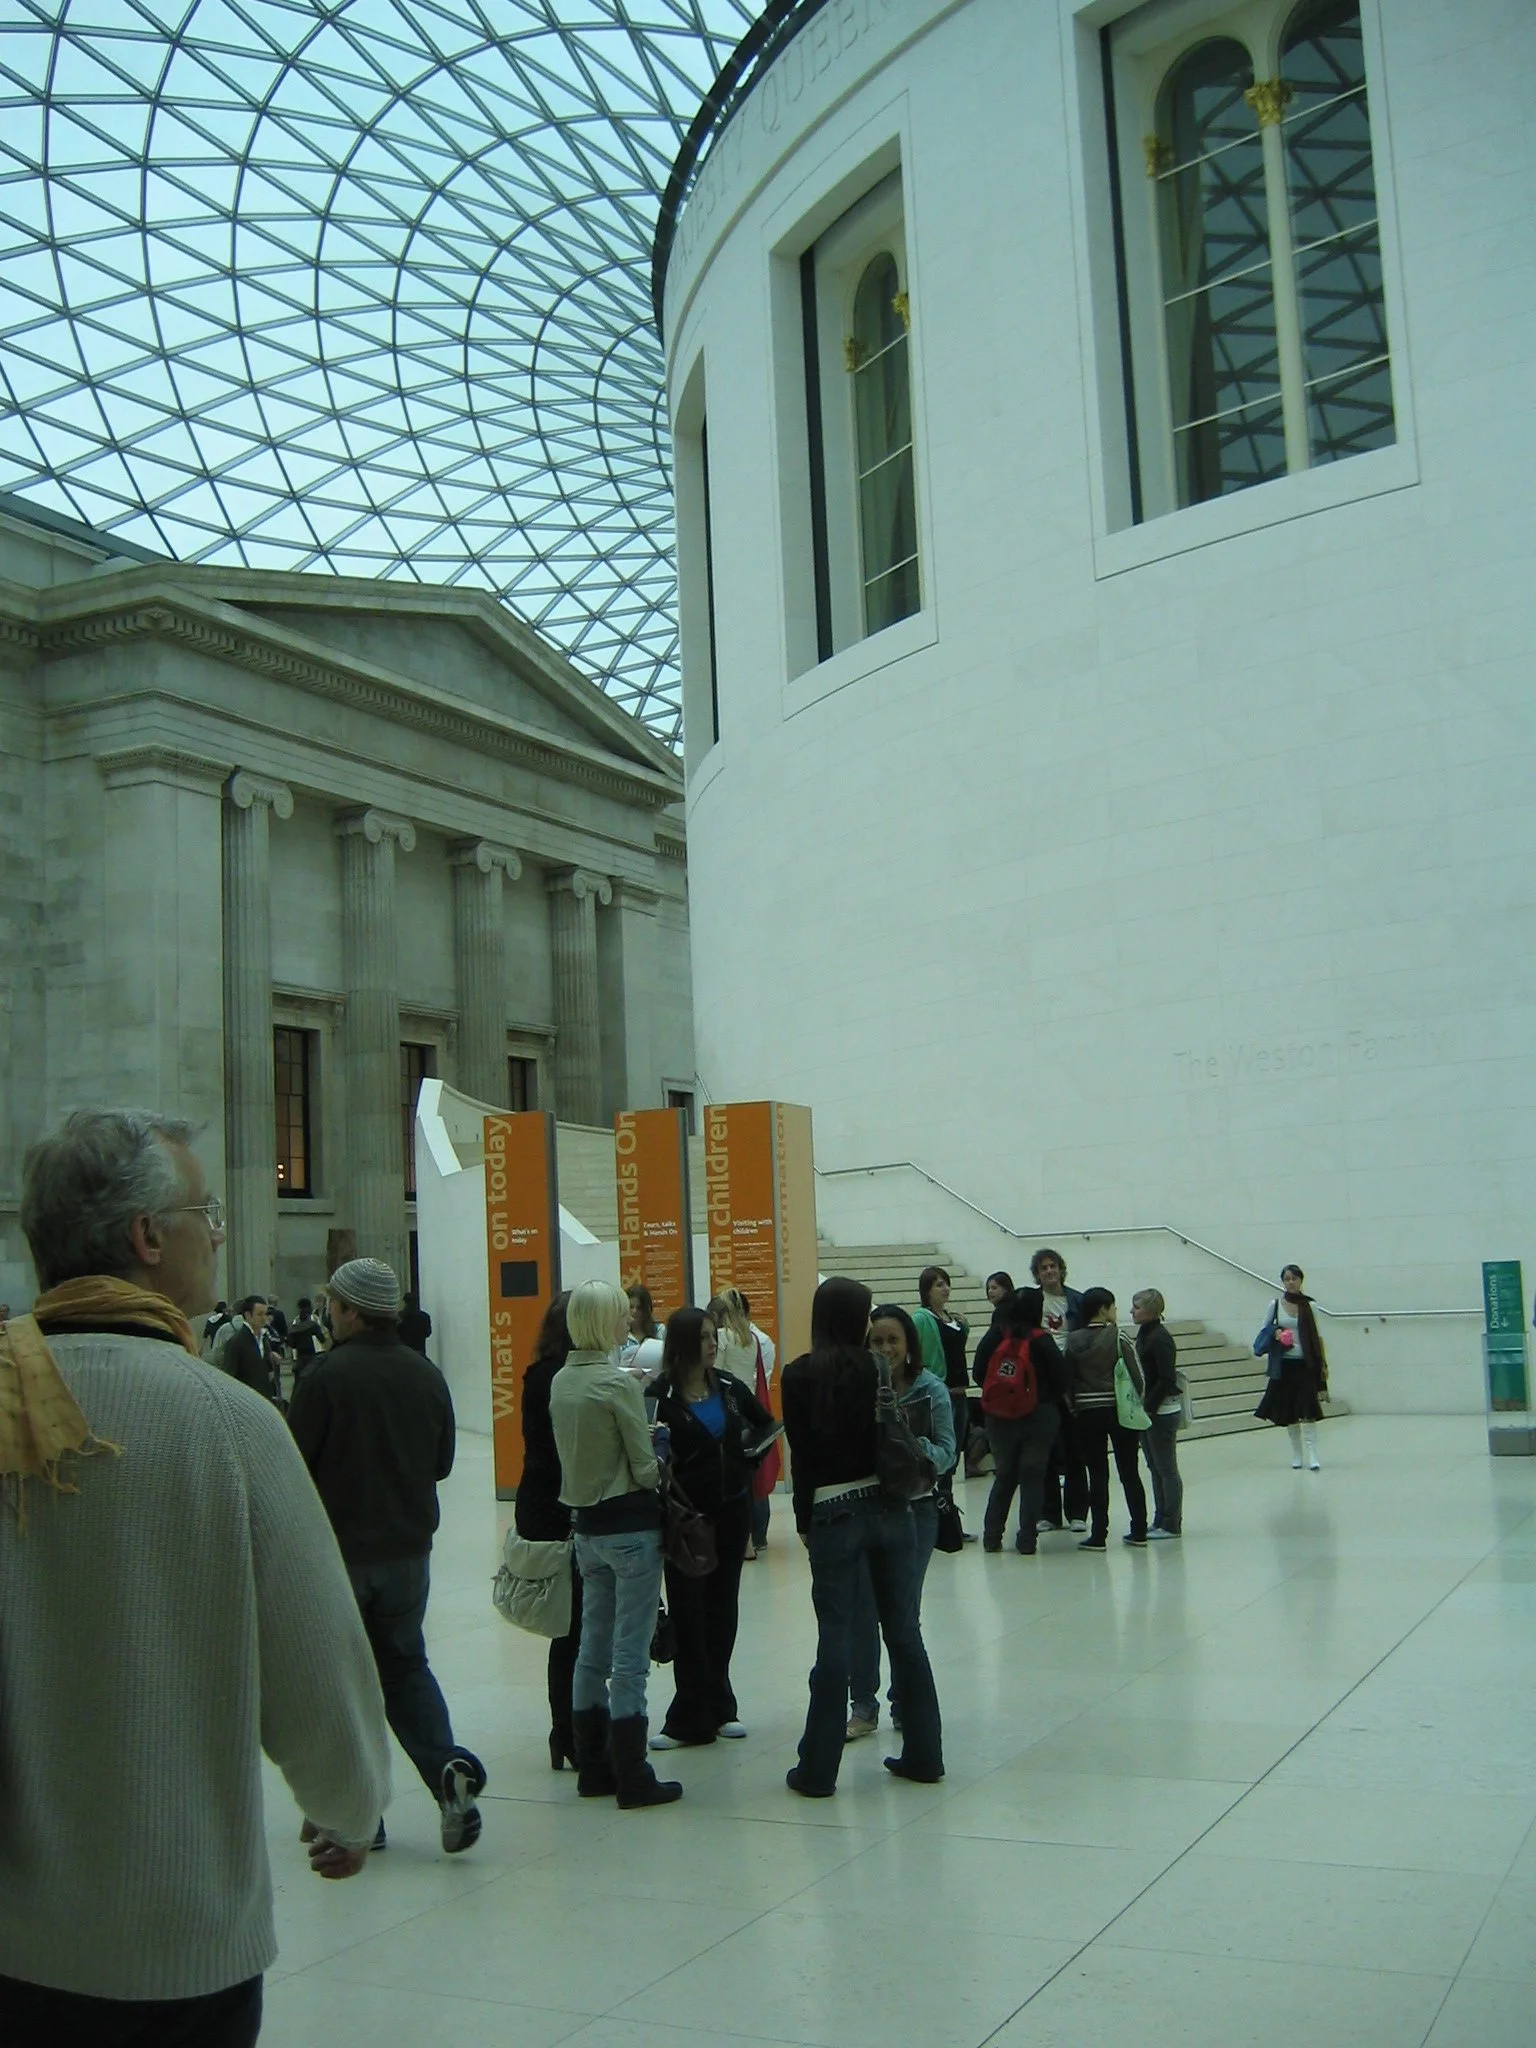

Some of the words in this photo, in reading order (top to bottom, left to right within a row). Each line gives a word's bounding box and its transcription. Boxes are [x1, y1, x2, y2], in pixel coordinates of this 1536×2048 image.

[1173, 1049, 1218, 1079] The
[1225, 1041, 1335, 1077] Weston
[615, 1110, 637, 1156] On
[484, 1115, 513, 1205] today
[705, 1103, 732, 1227] children
[617, 1162, 641, 1258] Hands
[776, 1101, 790, 1284] Information
[491, 1211, 509, 1251] on
[733, 1220, 757, 1228] Visiting
[733, 1227, 758, 1235] children
[620, 1263, 642, 1291] &
[1488, 1274, 1499, 1329] Donations
[490, 1311, 515, 1421] What's
